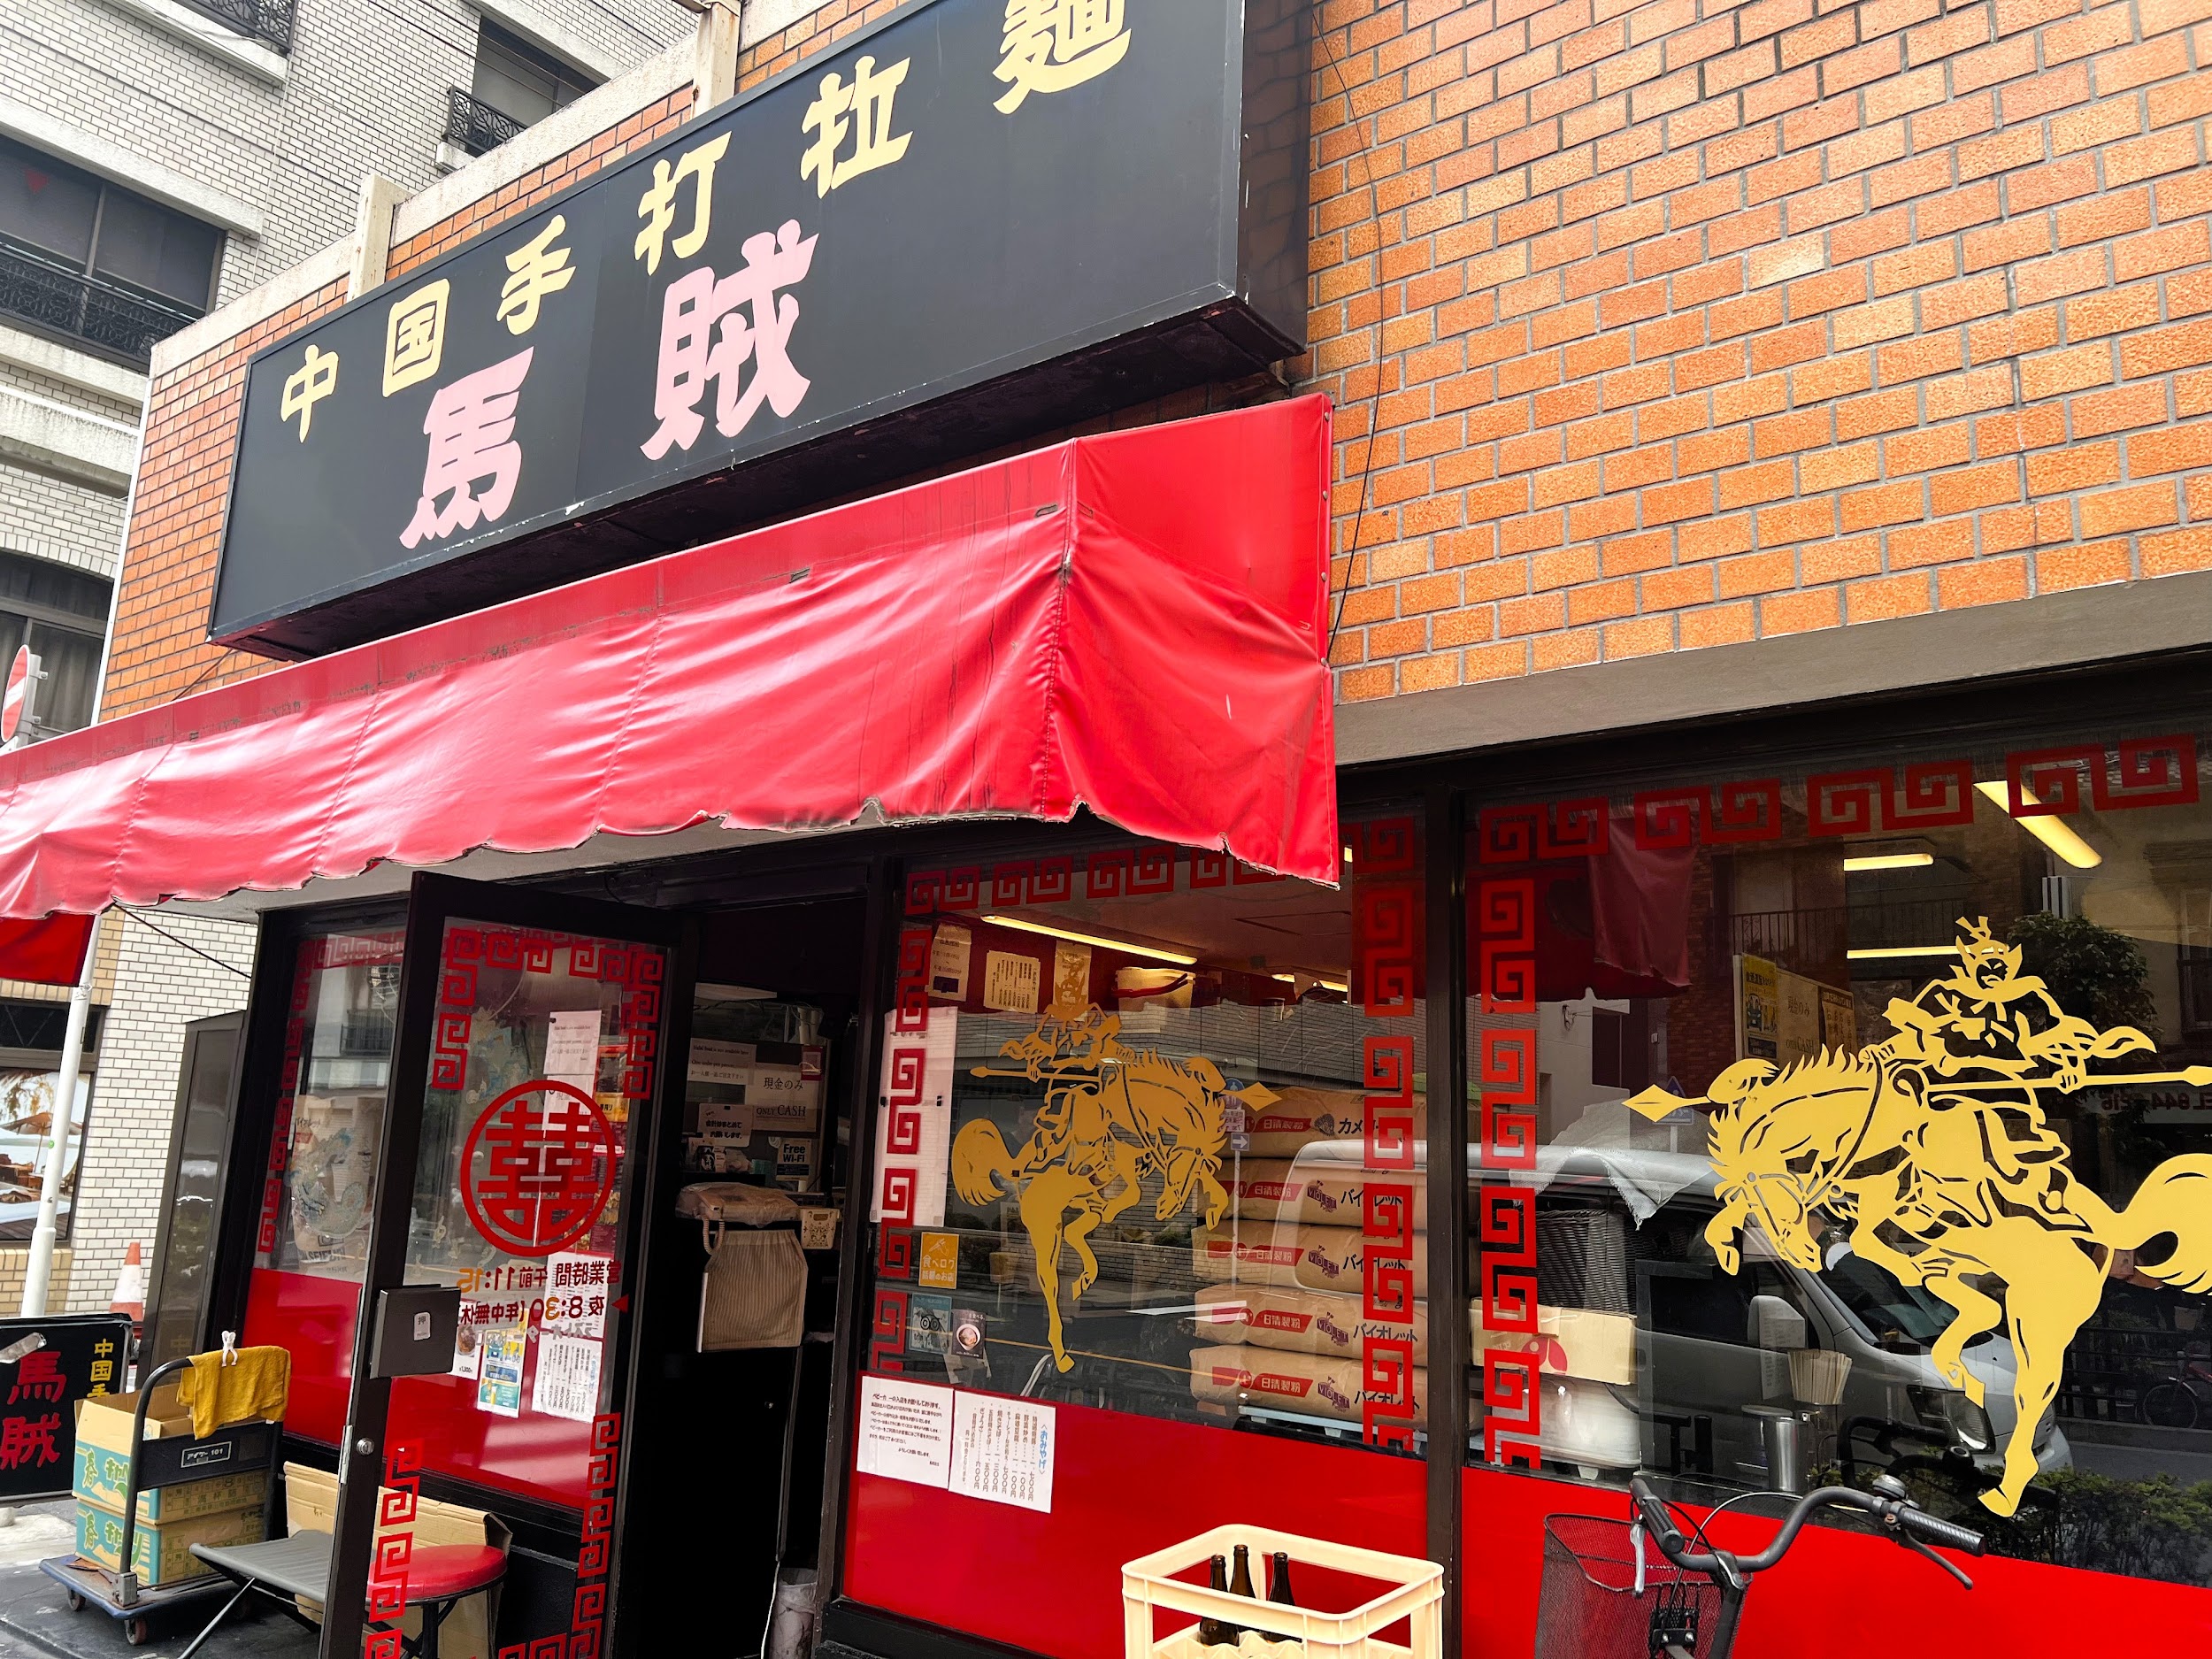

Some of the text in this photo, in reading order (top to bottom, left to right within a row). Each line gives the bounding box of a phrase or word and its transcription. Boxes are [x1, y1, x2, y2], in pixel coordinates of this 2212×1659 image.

[399, 219, 819, 550] 馬賊
[764, 1077, 803, 1090] 現金のみ
[756, 1105, 806, 1118] ONLY CASH
[1263, 1118, 1305, 1132] 日清製粉
[784, 1143, 805, 1154] Free
[783, 1154, 804, 1163] Wi-Fi
[1255, 1184, 1294, 1197] 日清製粉
[1307, 1187, 1337, 1210] VIOLET
[922, 1254, 956, 1269] 食べログ
[1256, 1249, 1294, 1263] 日清製粉
[1309, 1252, 1340, 1276] VIOLET
[1263, 1314, 1302, 1329] 日清製粉
[1317, 1317, 1349, 1343] VIOLET
[1353, 1323, 1418, 1342] バイオレット
[1261, 1378, 1302, 1394] 日清製粉
[1318, 1381, 1350, 1407] VIOLET
[0, 1351, 66, 1471] 馬賊
